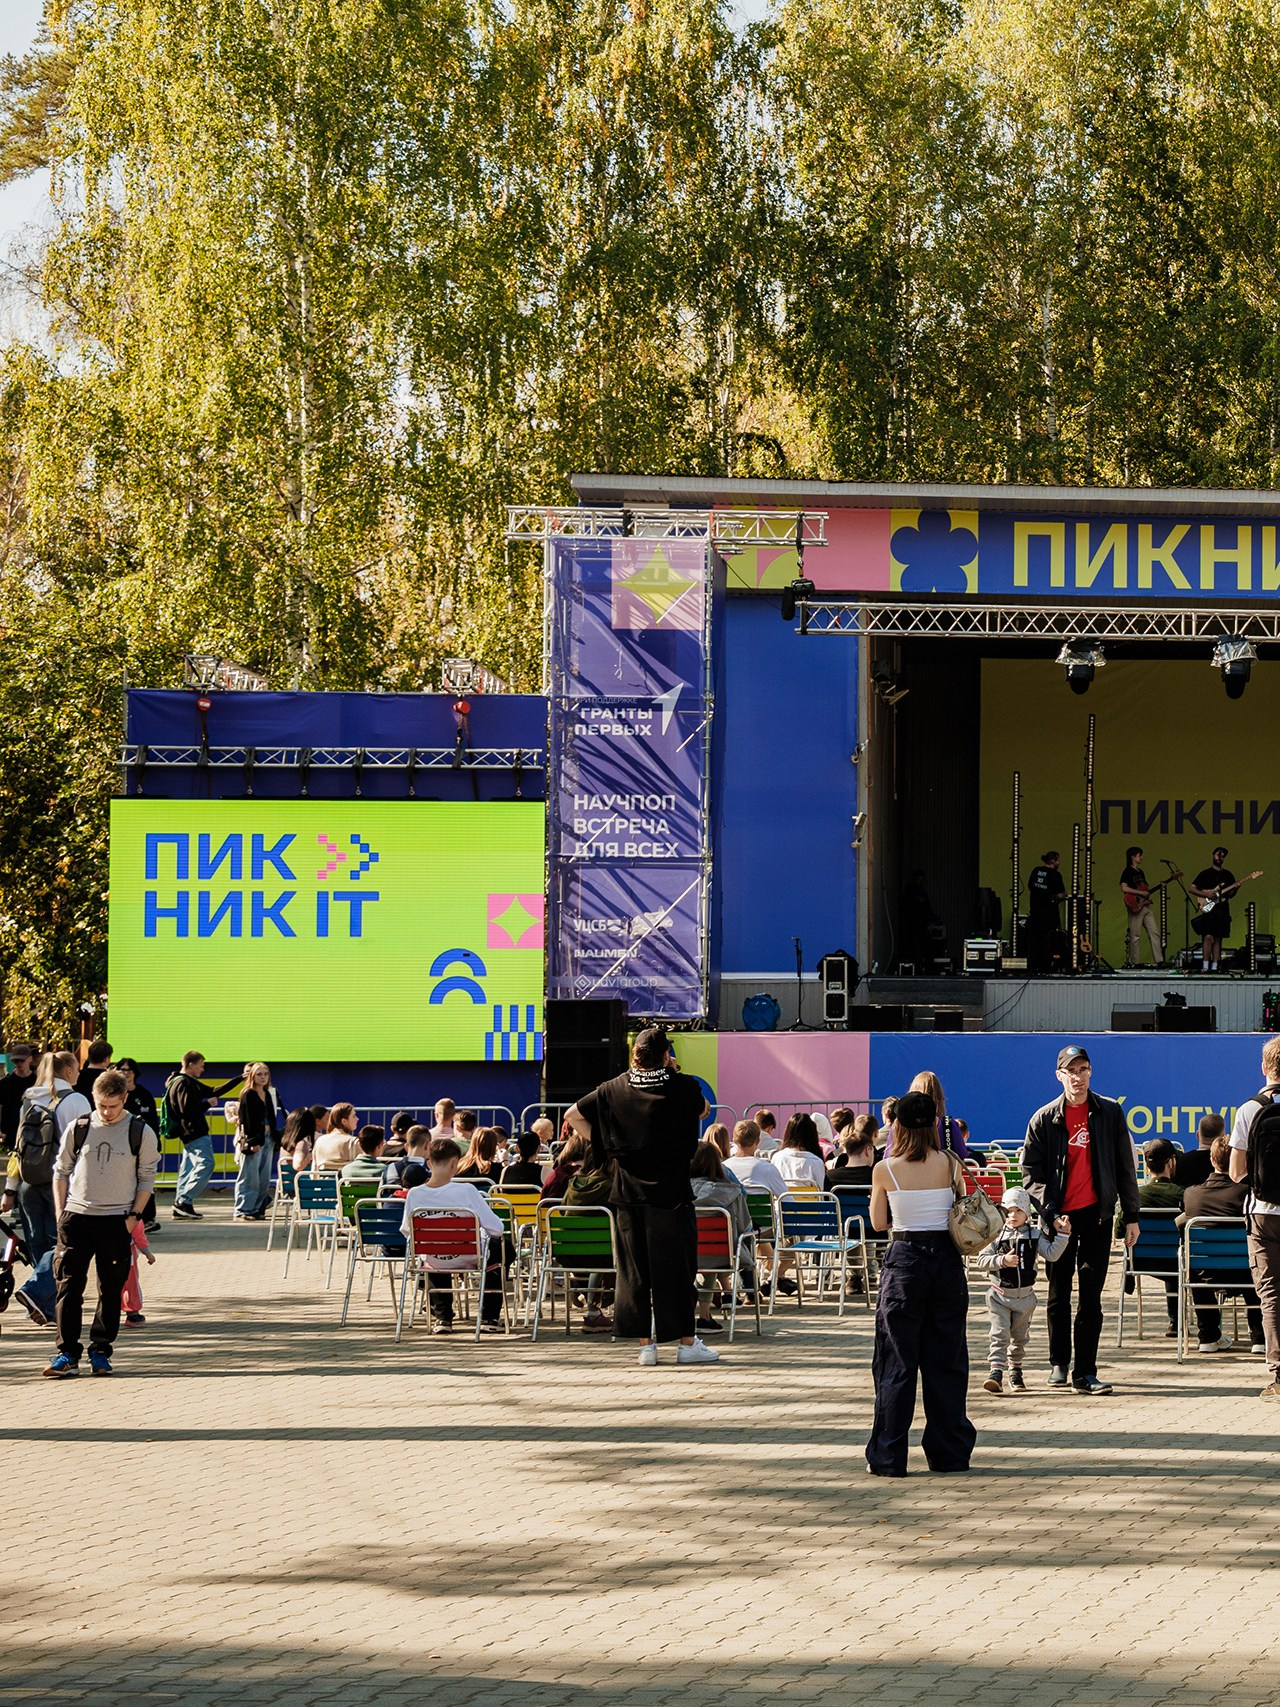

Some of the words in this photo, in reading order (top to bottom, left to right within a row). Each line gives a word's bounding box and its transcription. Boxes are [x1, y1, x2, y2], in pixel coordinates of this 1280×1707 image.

[580, 707, 653, 720] ГРАНТЫ
[574, 723, 652, 736] ПЕРВЫХ
[573, 794, 676, 811] НАУЧПОП
[573, 818, 670, 834] ВСТРЕЧА
[145, 833, 297, 880] ПИК
[573, 842, 619, 859] ДЛЯ
[624, 842, 679, 858] ВСЕХ
[144, 891, 297, 937] НИК
[316, 891, 380, 937] IT
[574, 920, 606, 933] УЦСБ
